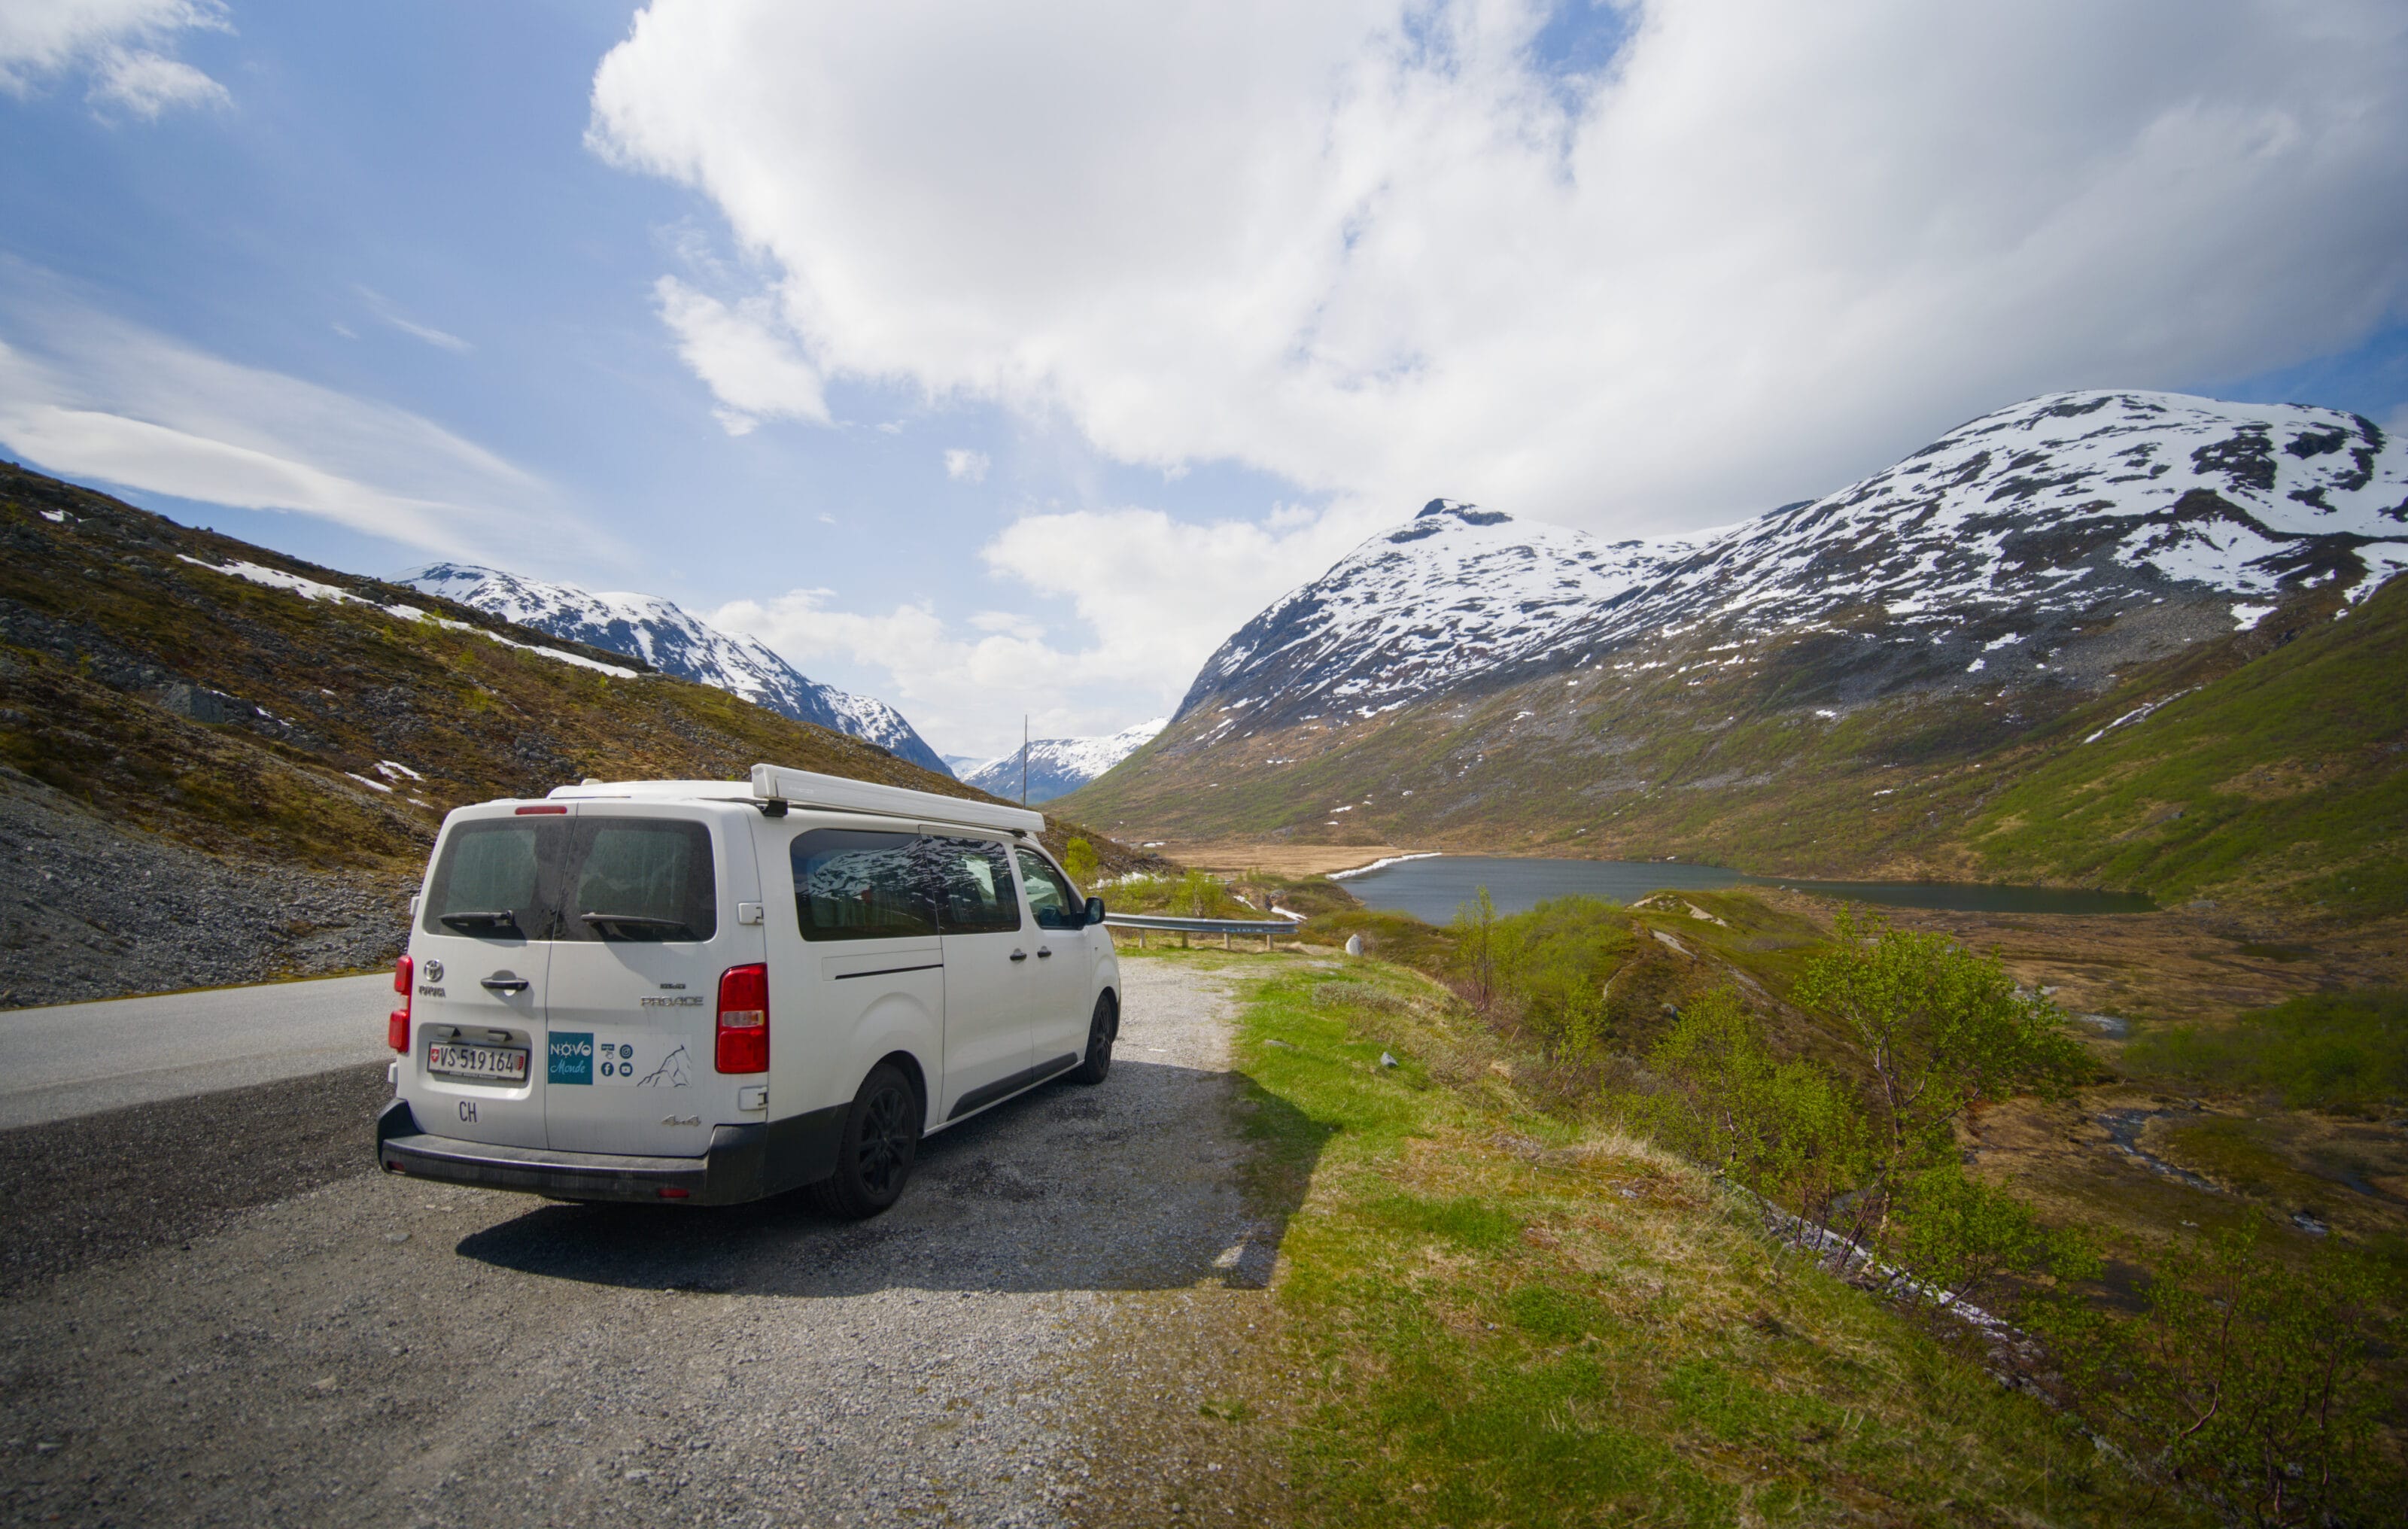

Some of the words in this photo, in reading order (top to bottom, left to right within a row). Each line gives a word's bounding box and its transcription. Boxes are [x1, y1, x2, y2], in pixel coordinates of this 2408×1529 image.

[418, 985, 446, 998] TOYOTA
[640, 996, 704, 1006] PROACE
[550, 1059, 585, 1075] Monde
[459, 1101, 477, 1123] CH
